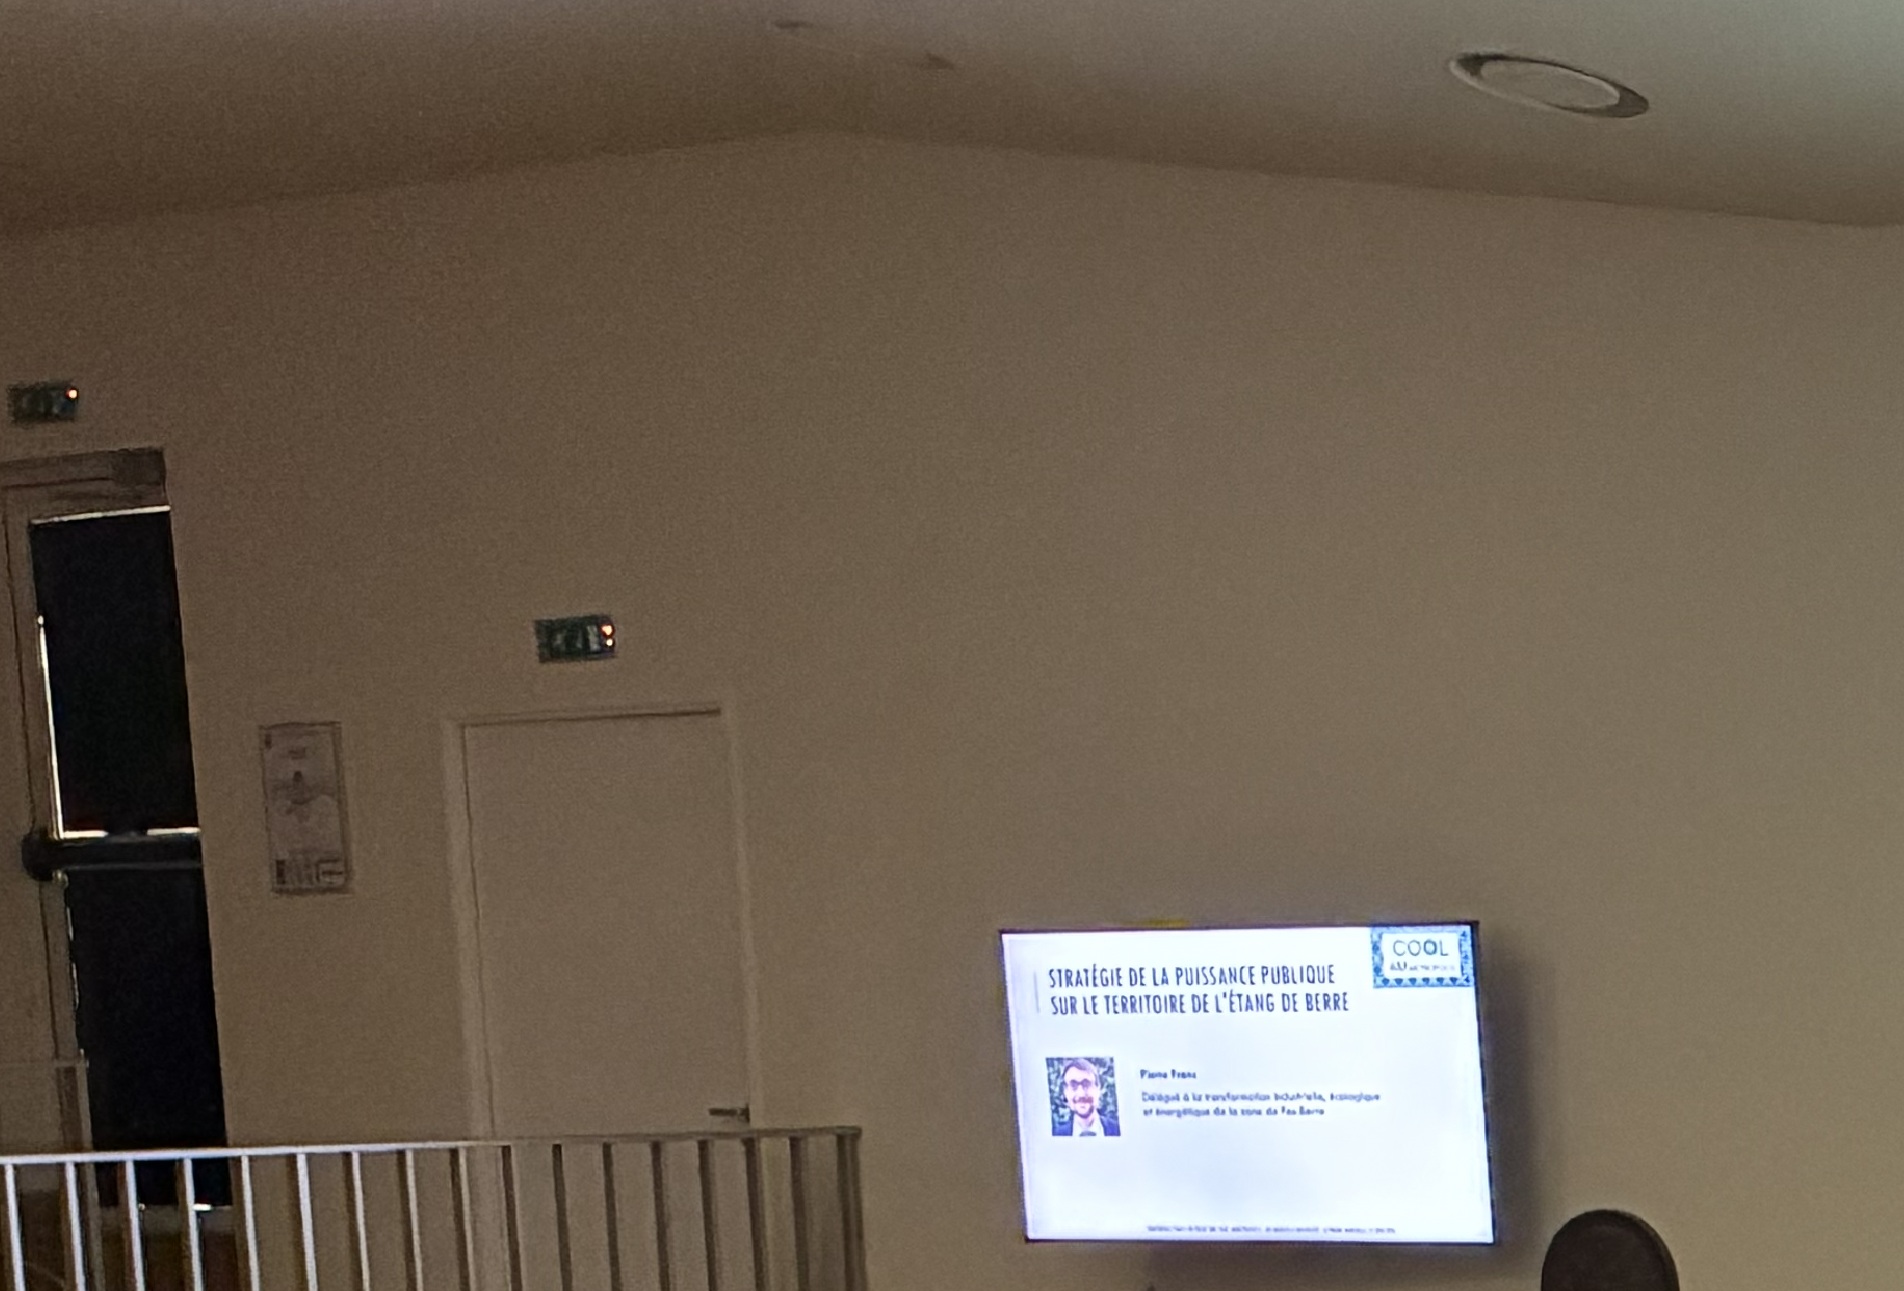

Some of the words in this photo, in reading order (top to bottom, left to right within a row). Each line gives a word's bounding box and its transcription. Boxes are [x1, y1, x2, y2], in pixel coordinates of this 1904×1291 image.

[1393, 939, 1449, 957] COOL
[1048, 963, 1124, 988] STRATÉGIE
[1129, 967, 1147, 986] DE
[1152, 967, 1169, 986] LA
[1175, 965, 1256, 986] PUISSANCE
[1261, 964, 1335, 985] PUBLIQUE
[1050, 995, 1078, 1015] SUR
[1083, 994, 1099, 1015] LE
[1103, 994, 1186, 1014] TERRITOIRE
[1191, 993, 1209, 1014] DE
[1214, 989, 1275, 1013] L'ÉTANG
[1282, 992, 1298, 1013] DE
[1306, 991, 1350, 1012] BERRE
